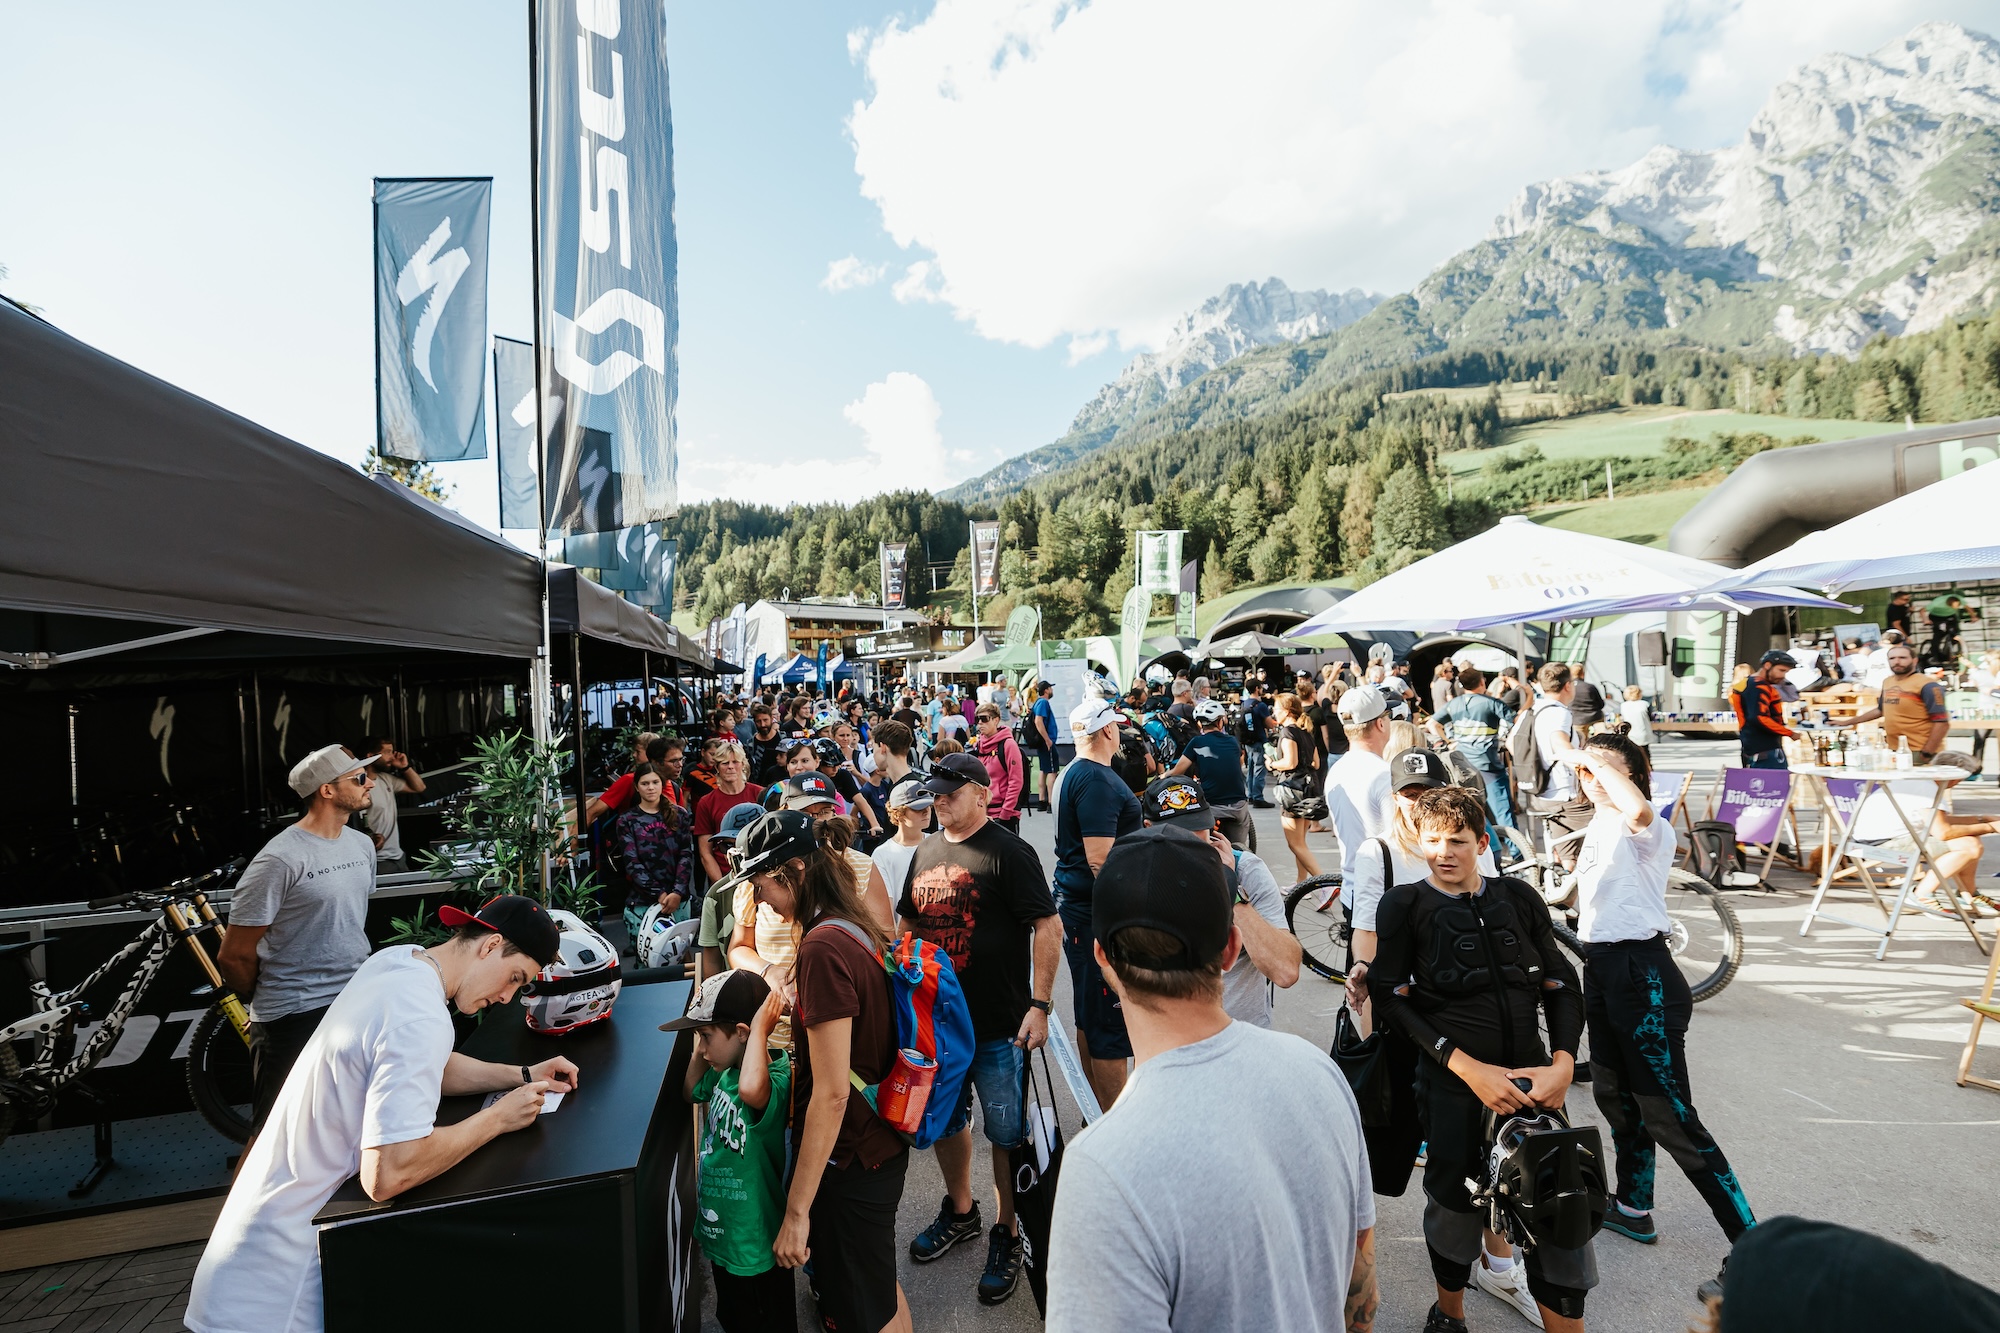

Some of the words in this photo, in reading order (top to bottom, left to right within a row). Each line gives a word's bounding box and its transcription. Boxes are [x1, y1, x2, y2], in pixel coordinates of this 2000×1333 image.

[1176, 591, 1193, 637] bike
[723, 648, 734, 692] coex
[1673, 610, 1723, 699] bik
[1724, 788, 1785, 808] Bitburger
[318, 868, 330, 876] NO
